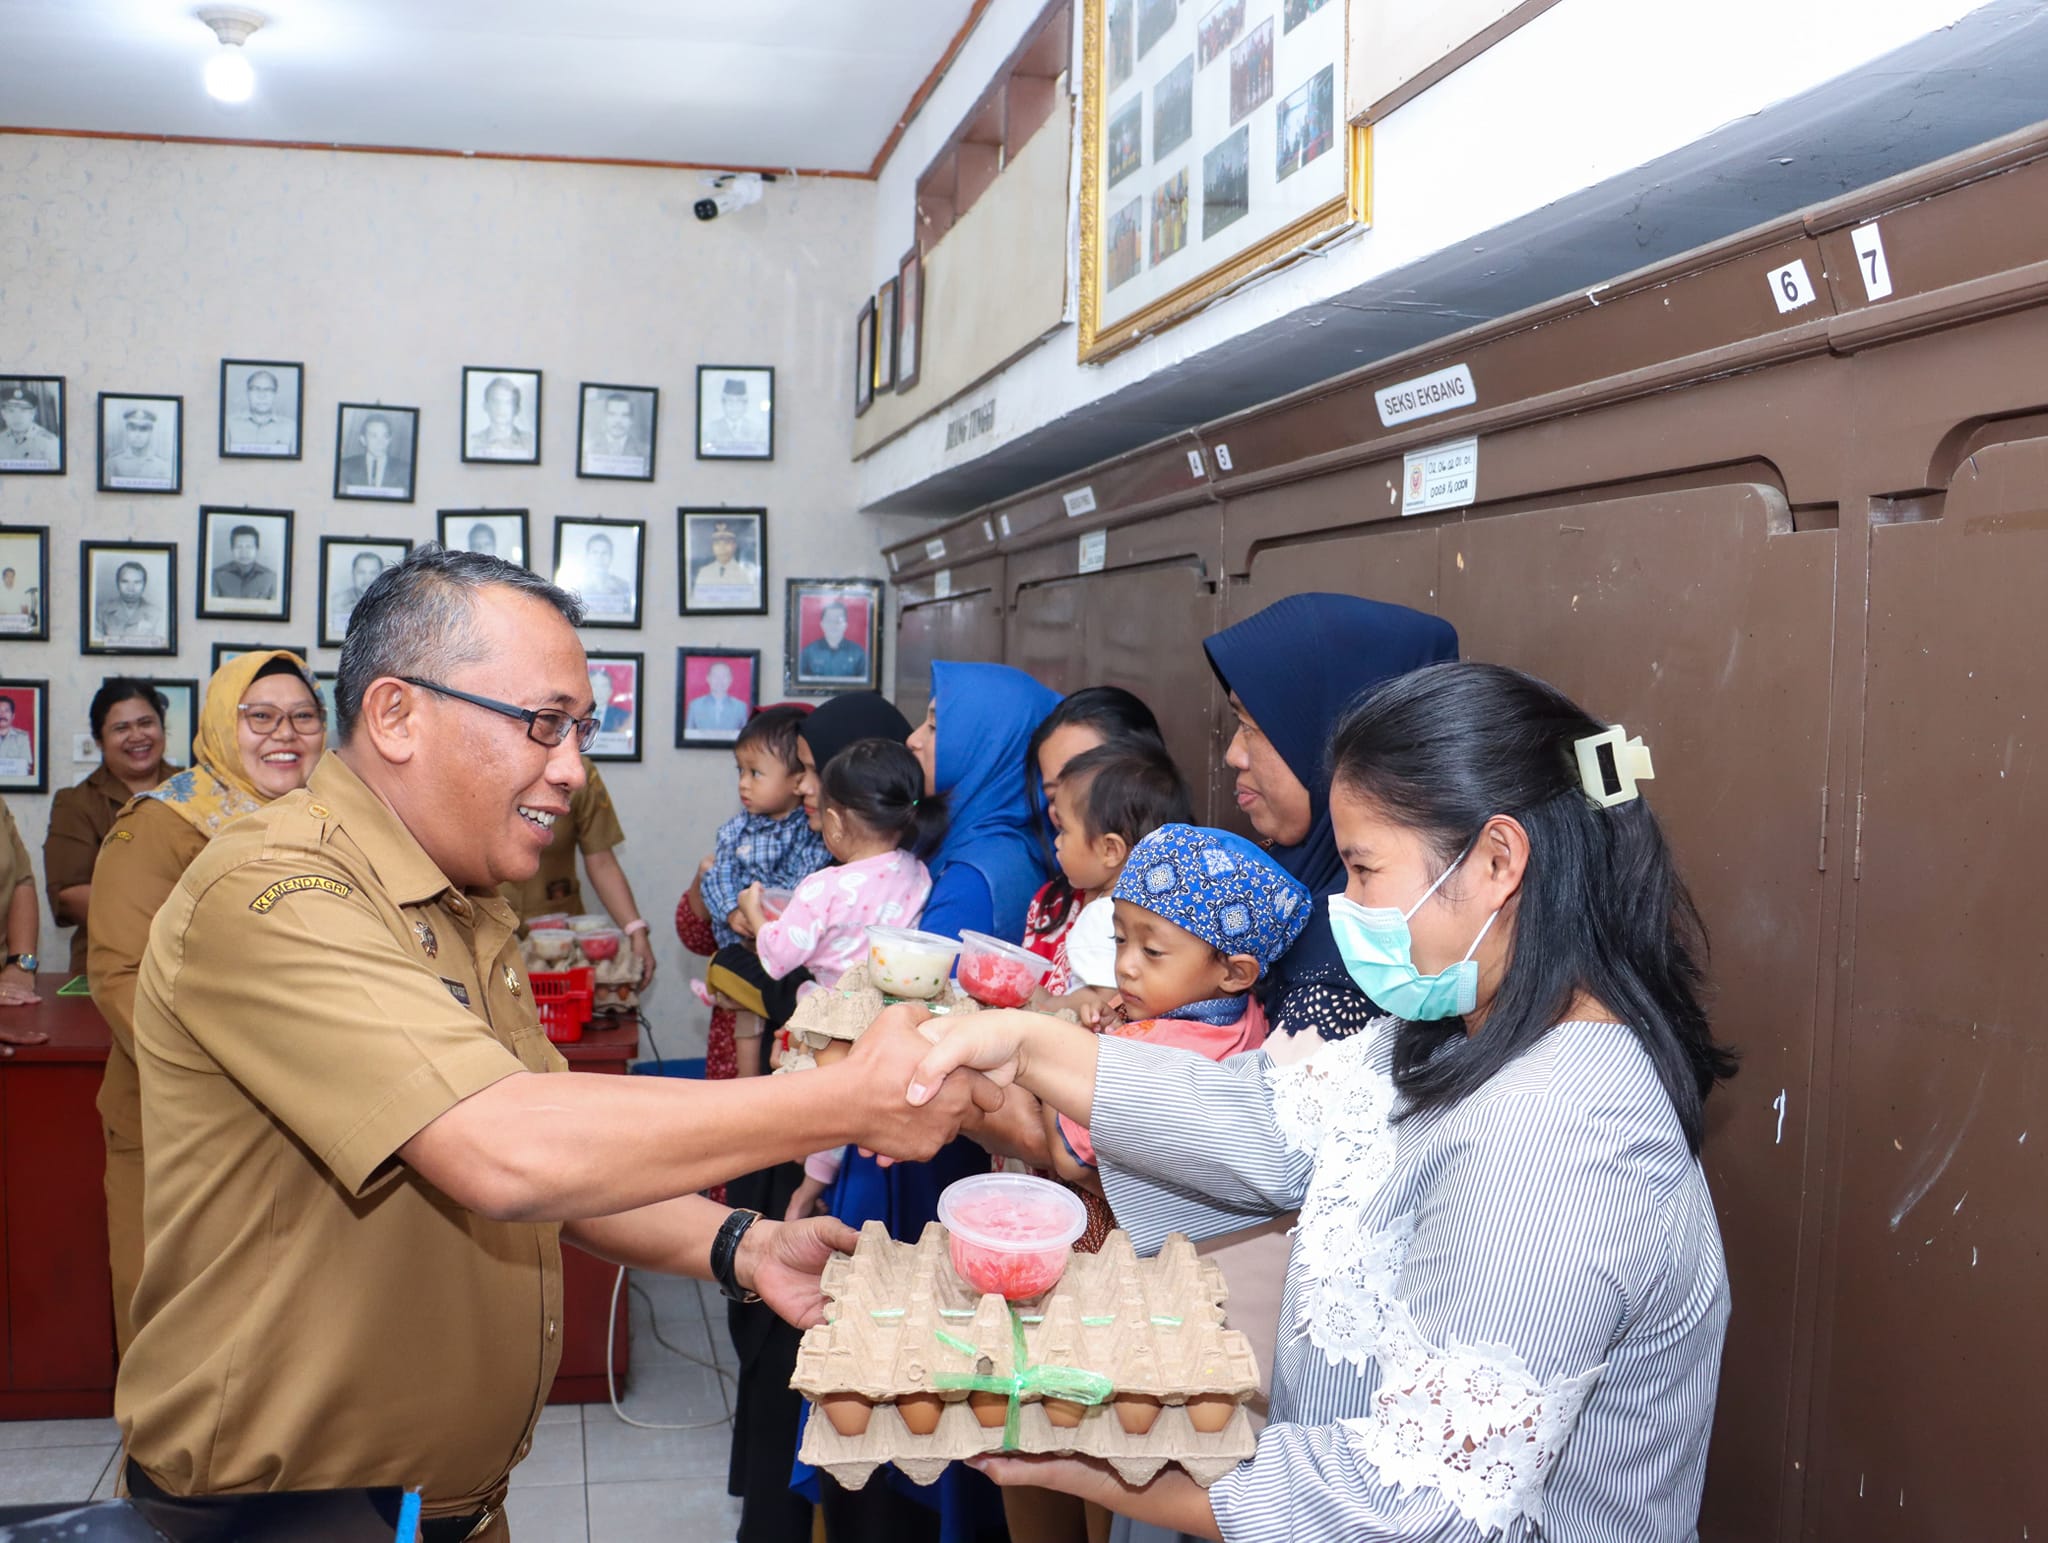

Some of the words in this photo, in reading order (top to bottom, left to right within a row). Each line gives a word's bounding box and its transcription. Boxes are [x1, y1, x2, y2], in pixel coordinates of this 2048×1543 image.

[1861, 248, 1878, 285] 7
[1780, 270, 1799, 302] 6
[1384, 391, 1417, 416] SEKSI
[1416, 377, 1465, 406] EKBANG
[256, 878, 347, 909] KEMENDAGRI
